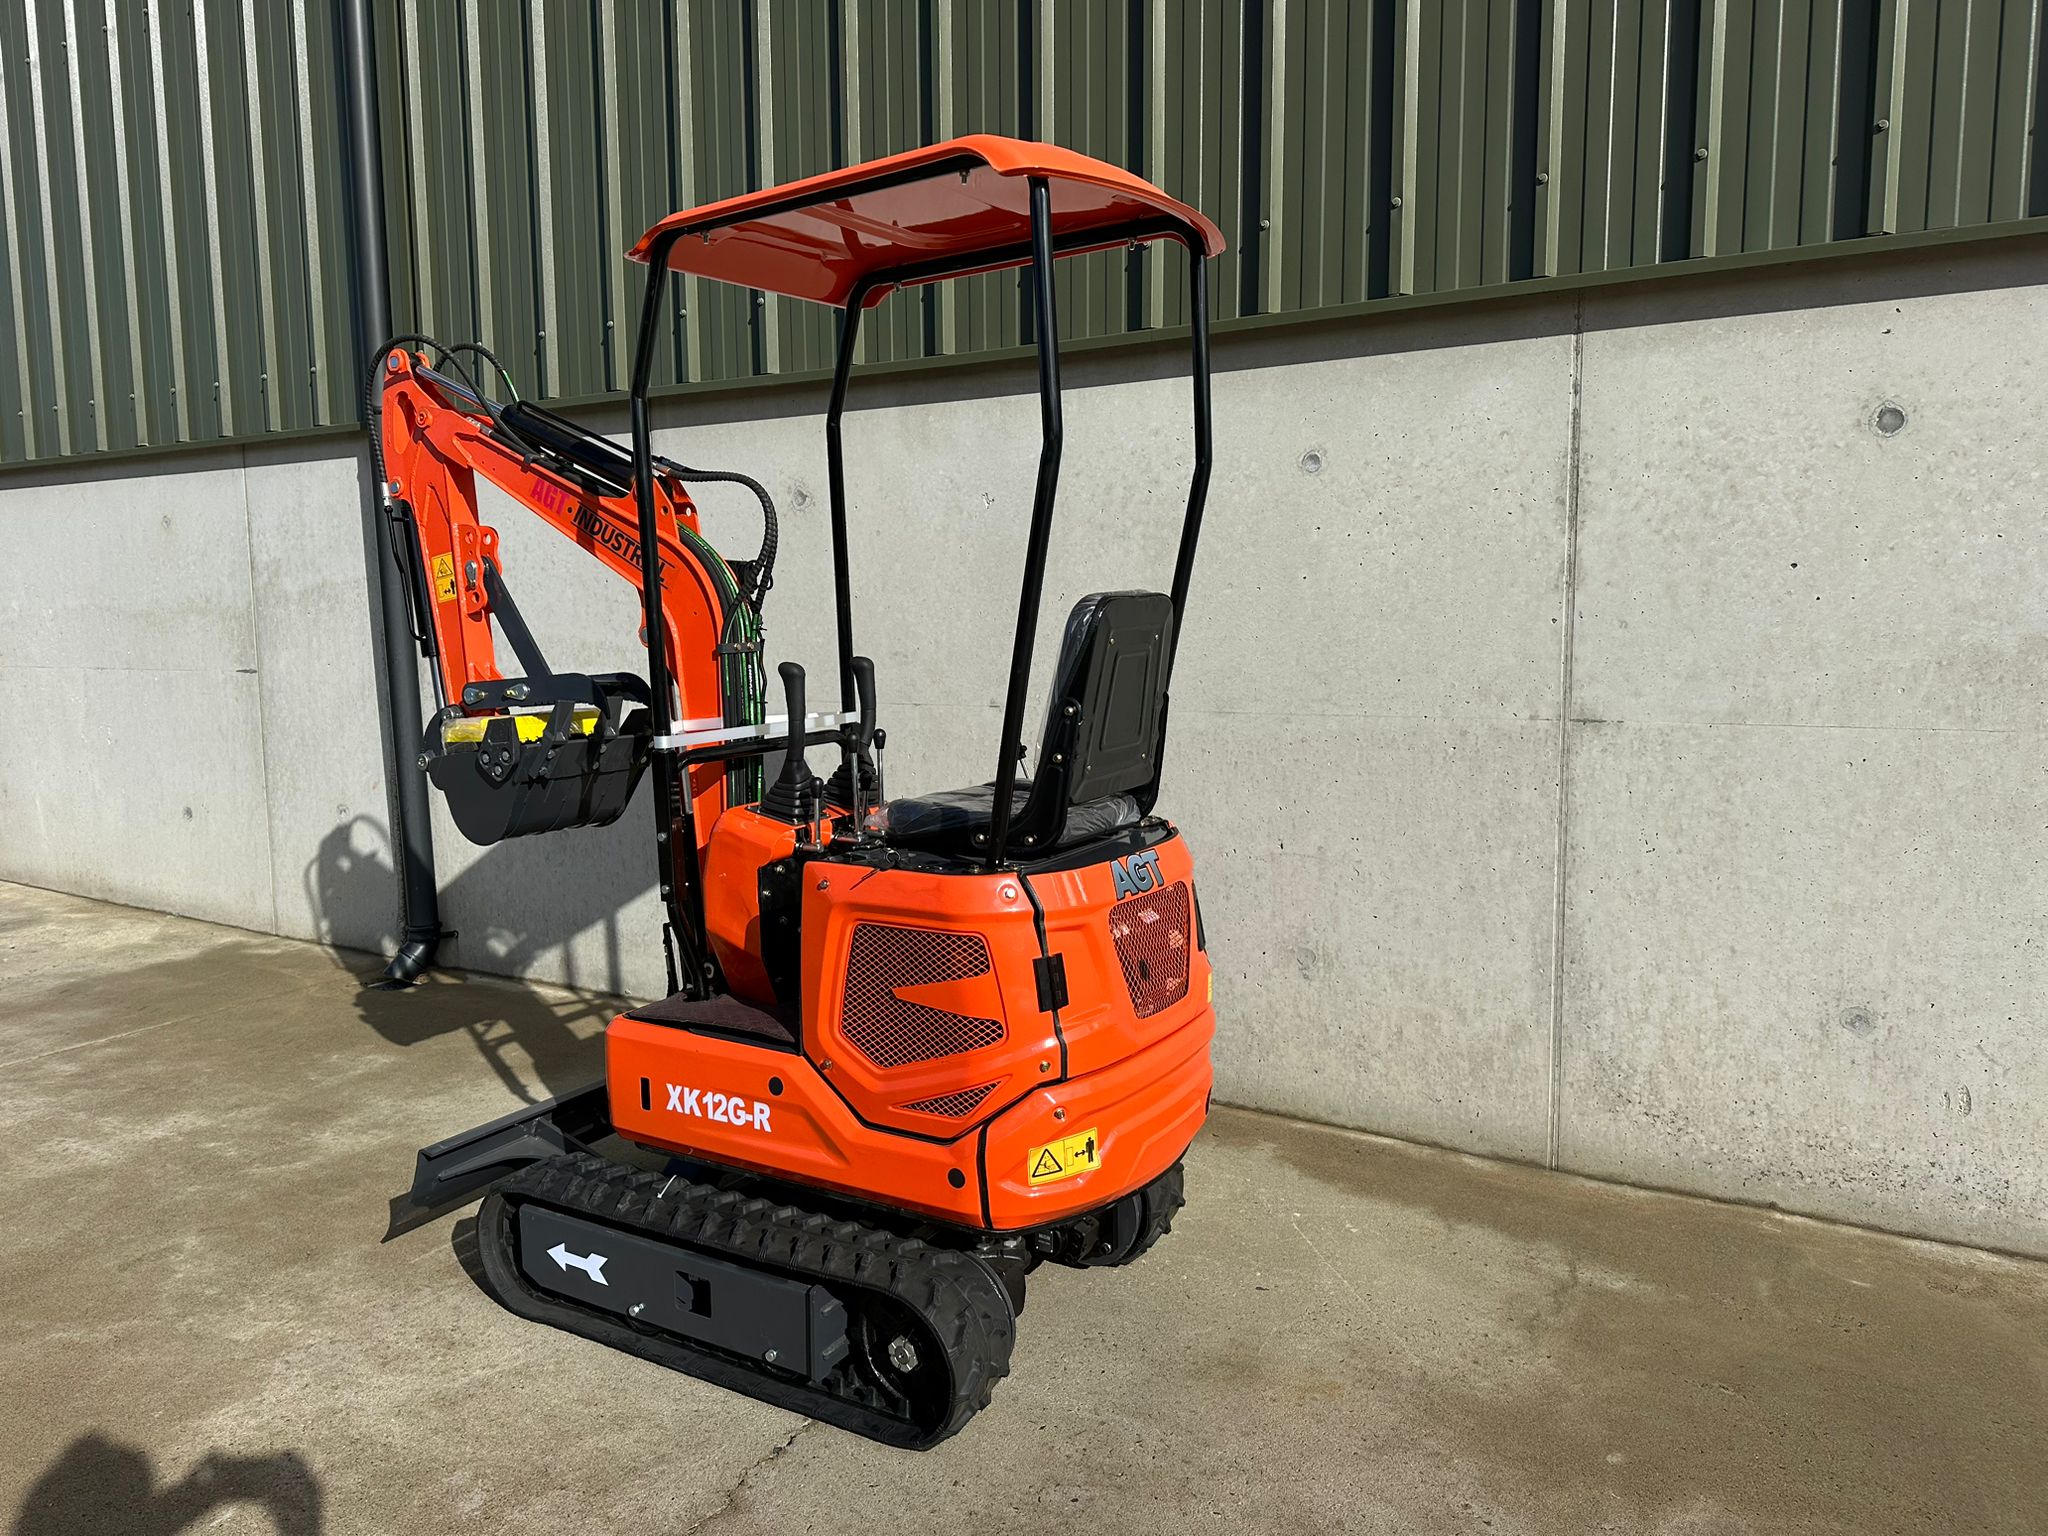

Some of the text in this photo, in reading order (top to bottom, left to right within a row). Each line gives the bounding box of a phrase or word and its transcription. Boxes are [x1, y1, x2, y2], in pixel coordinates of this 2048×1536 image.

[530, 477, 665, 583] AGT INDUSTRL
[1110, 848, 1164, 901] AGT
[666, 1083, 772, 1133] XK12G-R
